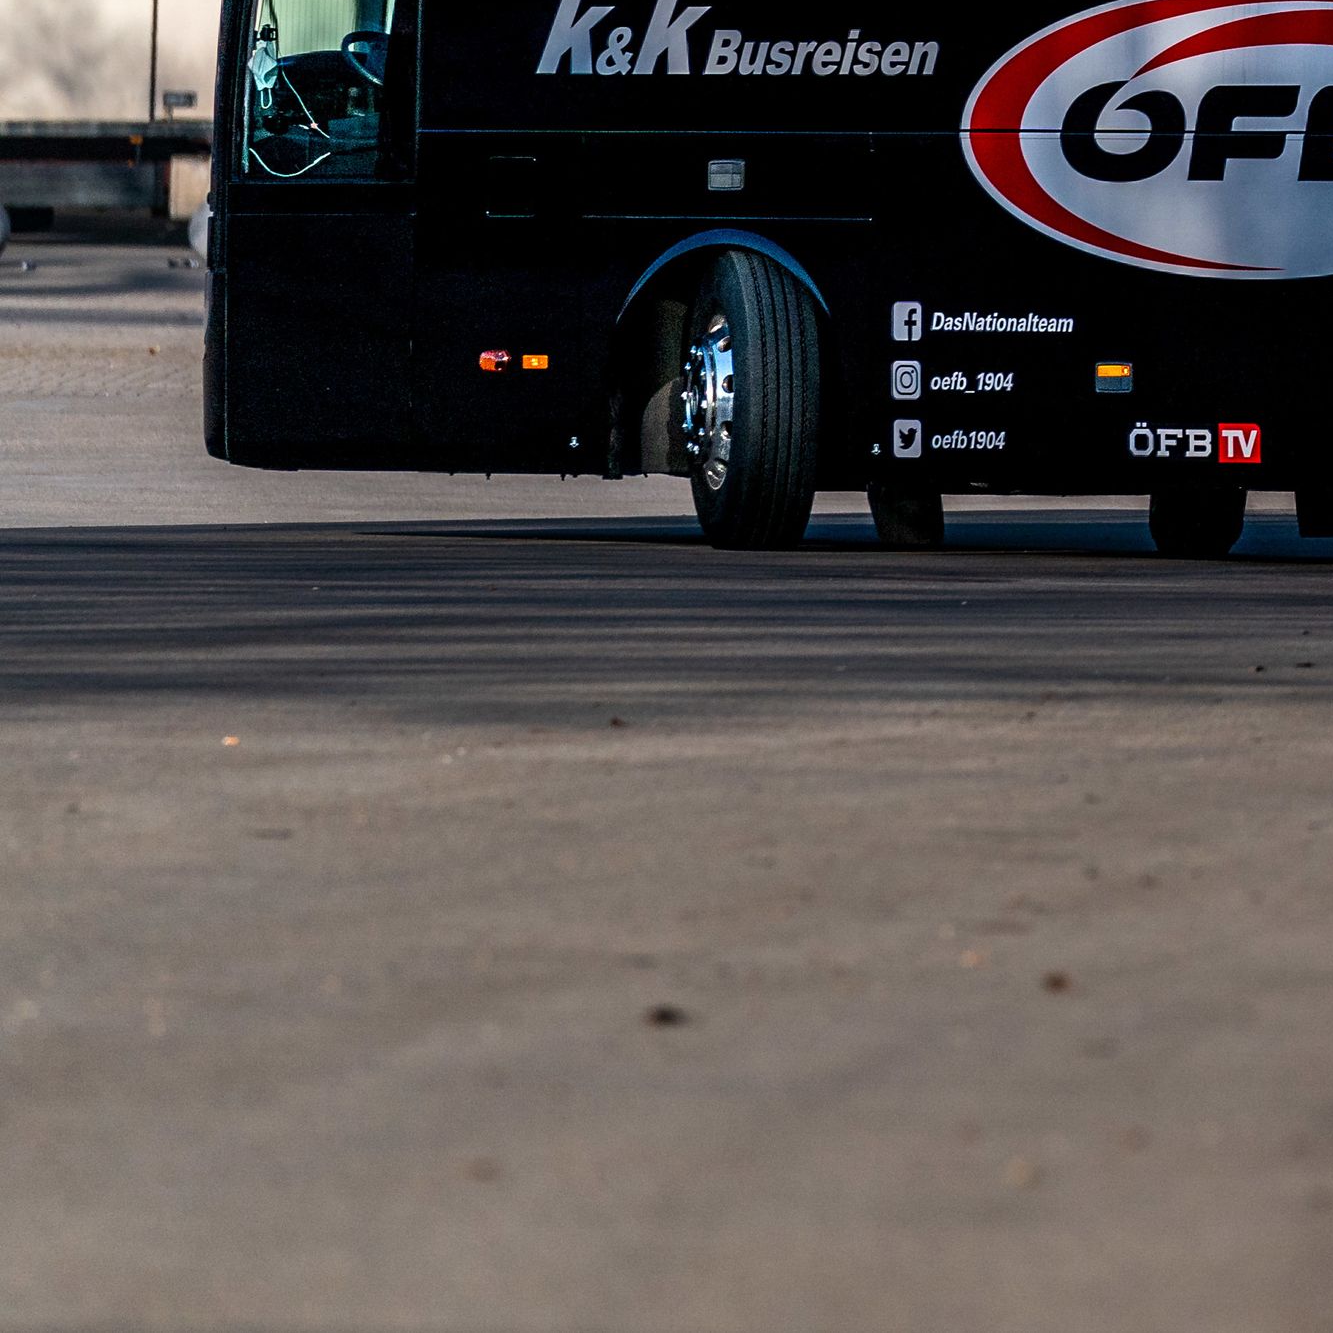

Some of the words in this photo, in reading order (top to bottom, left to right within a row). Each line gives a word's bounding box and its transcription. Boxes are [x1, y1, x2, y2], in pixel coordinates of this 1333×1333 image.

[703, 28, 939, 77] Busreisen
[931, 311, 1074, 333] DasNationalteam
[930, 371, 1014, 394] oefb_1904
[931, 429, 1006, 450] oefb1904
[1129, 421, 1212, 458] ÖFB
[1221, 429, 1258, 458] TV
